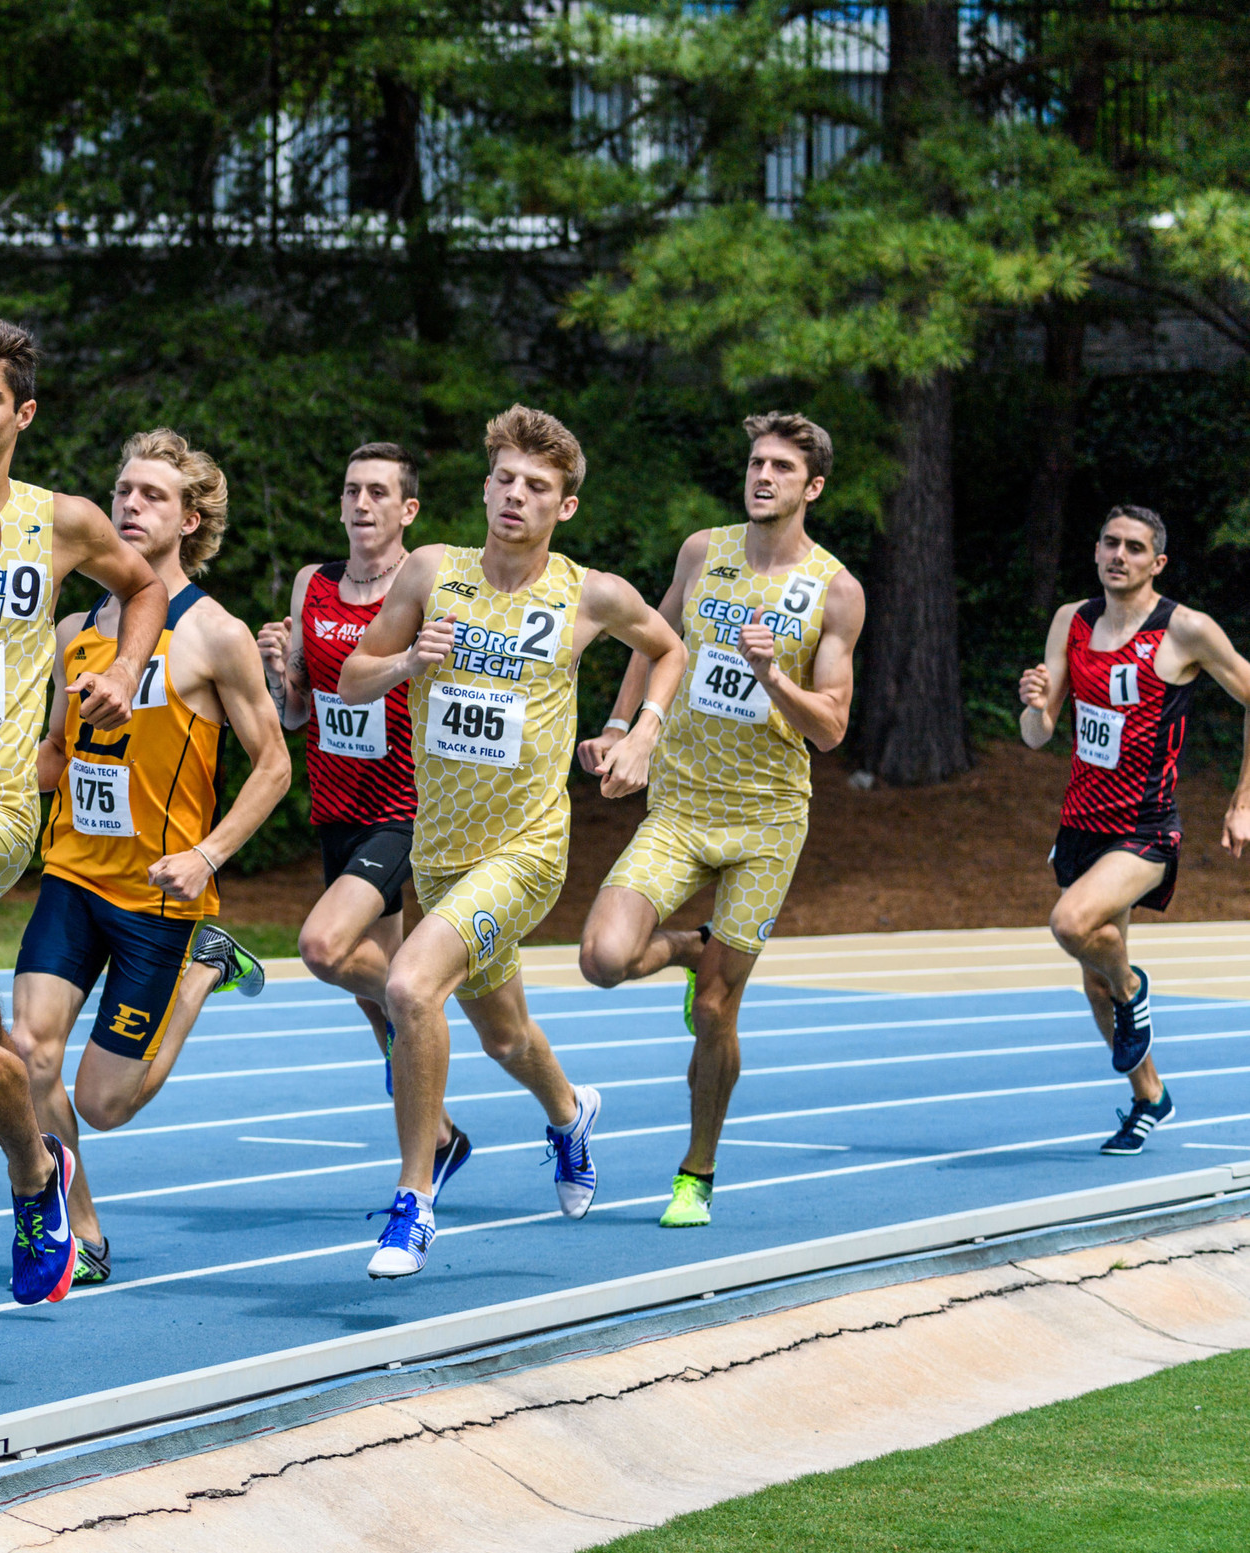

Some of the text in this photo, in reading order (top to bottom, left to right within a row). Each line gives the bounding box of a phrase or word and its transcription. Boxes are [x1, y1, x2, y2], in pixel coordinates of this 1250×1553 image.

[708, 566, 741, 580] ACC
[10, 566, 41, 617] 9
[440, 580, 478, 597] ACC
[784, 576, 816, 614] 5
[338, 623, 366, 636] ATLA
[520, 610, 555, 658] 2
[451, 646, 524, 682] TECH
[708, 650, 744, 667] GEORGIA
[442, 686, 514, 704] GEORGIA TECH
[705, 664, 758, 702] 487
[1116, 668, 1129, 702] 1
[318, 694, 345, 705] GEORG
[698, 696, 756, 718] TRACK & FIELD
[326, 706, 369, 738] 407
[442, 702, 506, 742] 495
[1080, 716, 1110, 748] 406
[356, 744, 375, 752] FIELD
[437, 740, 467, 753] TRACK
[470, 746, 476, 754] &
[480, 748, 506, 758] FIELD
[74, 762, 118, 778] GEORGIA TECH
[76, 776, 115, 814] 475
[91, 820, 97, 828] &
[100, 820, 121, 829] FIELD
[109, 1003, 150, 1041] E
